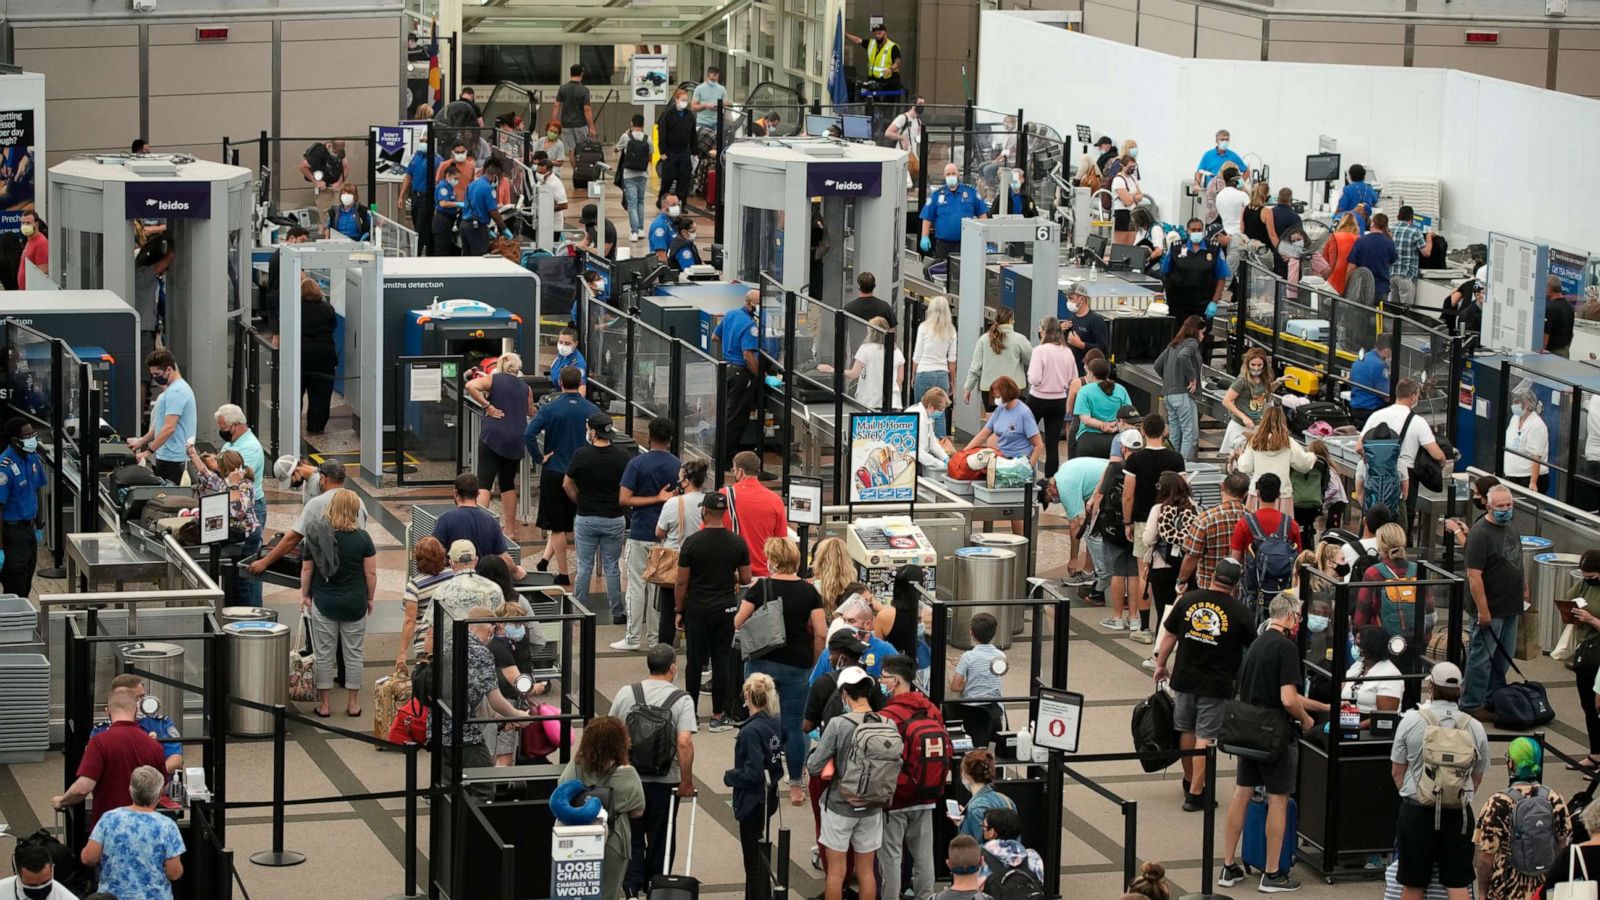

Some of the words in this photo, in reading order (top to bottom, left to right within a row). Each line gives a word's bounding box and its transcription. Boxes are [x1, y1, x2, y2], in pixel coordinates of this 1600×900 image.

[0, 120, 16, 128] ssed
[11, 128, 24, 137] day
[0, 136, 17, 146] ugh?
[836, 181, 863, 190] leidos
[159, 200, 189, 210] leidos
[2, 214, 20, 223] Prech
[1037, 226, 1049, 240] 6
[857, 421, 876, 430] Mail
[877, 421, 885, 430] It
[886, 421, 913, 430] Home
[857, 430, 886, 441] Safely!
[1205, 601, 1229, 632] PARADISE
[925, 737, 943, 757] H
[557, 861, 601, 873] LOOSE
[556, 871, 601, 881] CHANGE
[556, 886, 600, 897] WORLD
